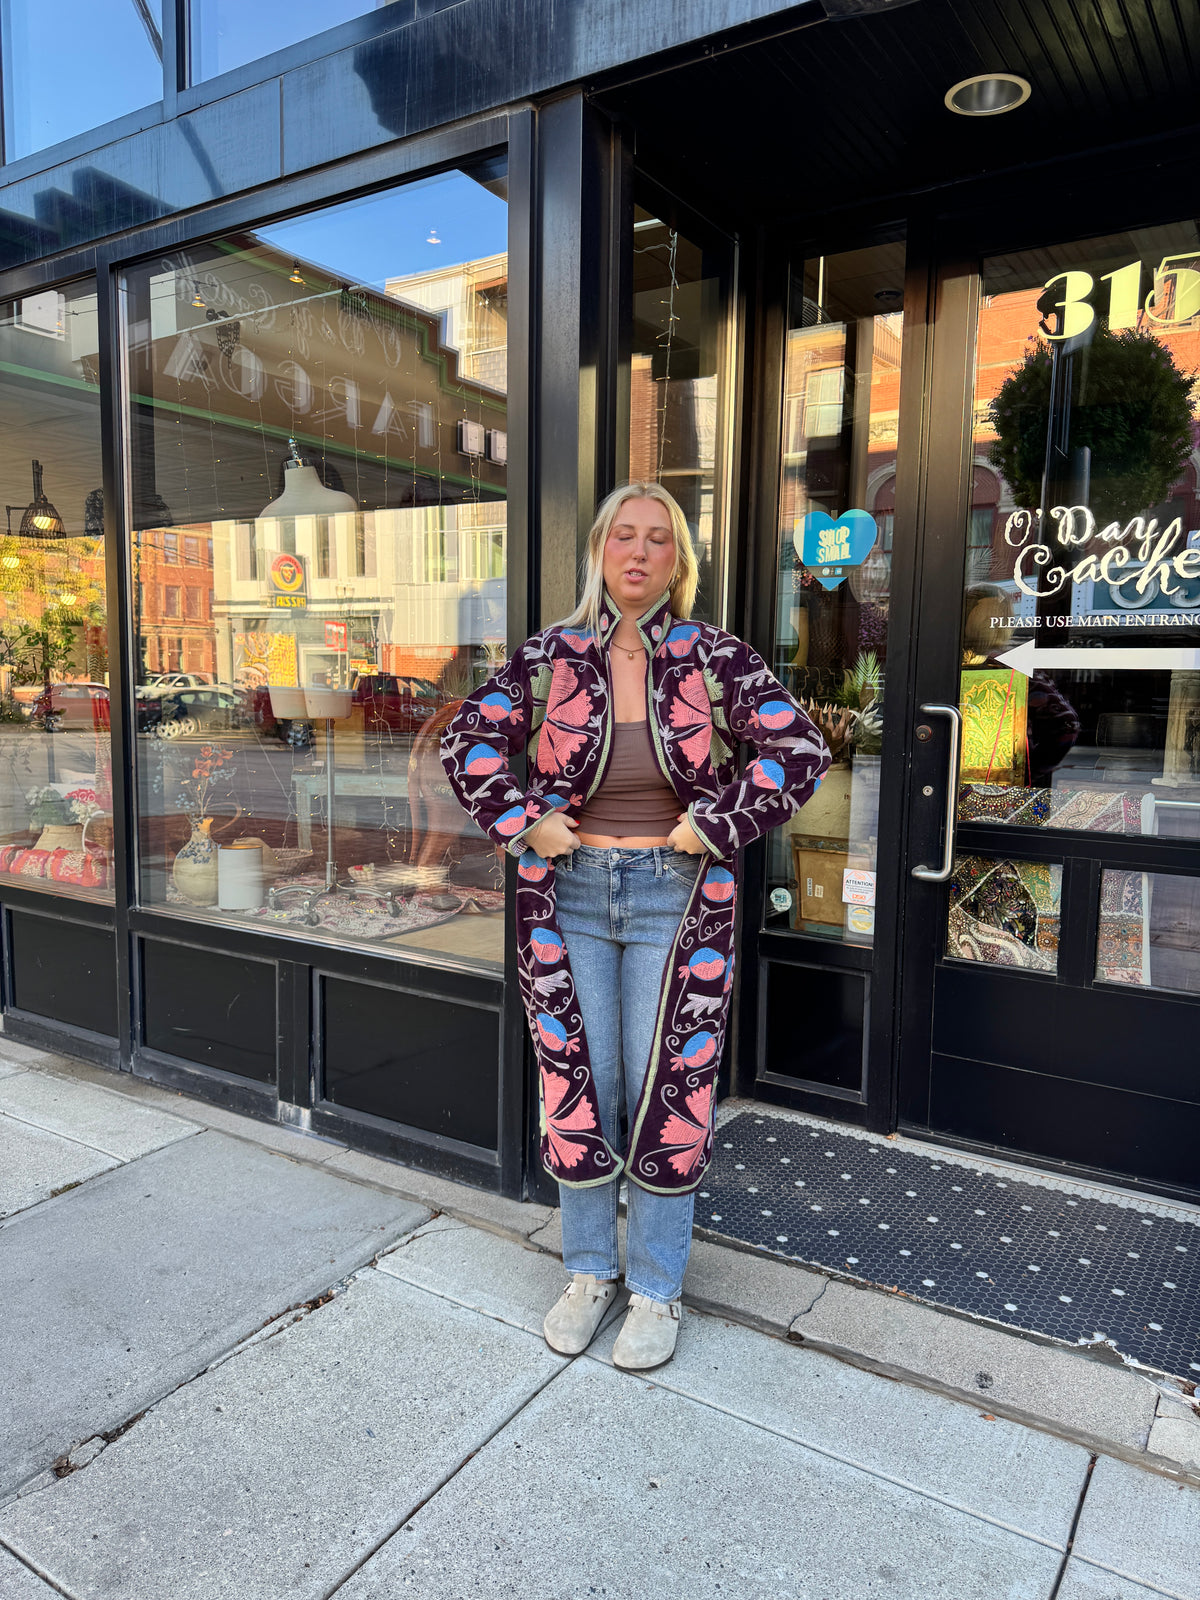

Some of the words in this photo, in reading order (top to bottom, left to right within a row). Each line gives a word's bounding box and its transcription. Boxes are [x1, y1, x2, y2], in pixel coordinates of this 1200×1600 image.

[1037, 251, 1200, 339] 315
[818, 526, 850, 547] SHOP
[1005, 505, 1159, 561] O'Day
[817, 543, 852, 563] SMALL
[989, 616, 1042, 628] PLEASE
[1045, 615, 1074, 628] USE
[1078, 615, 1121, 627] MAIN
